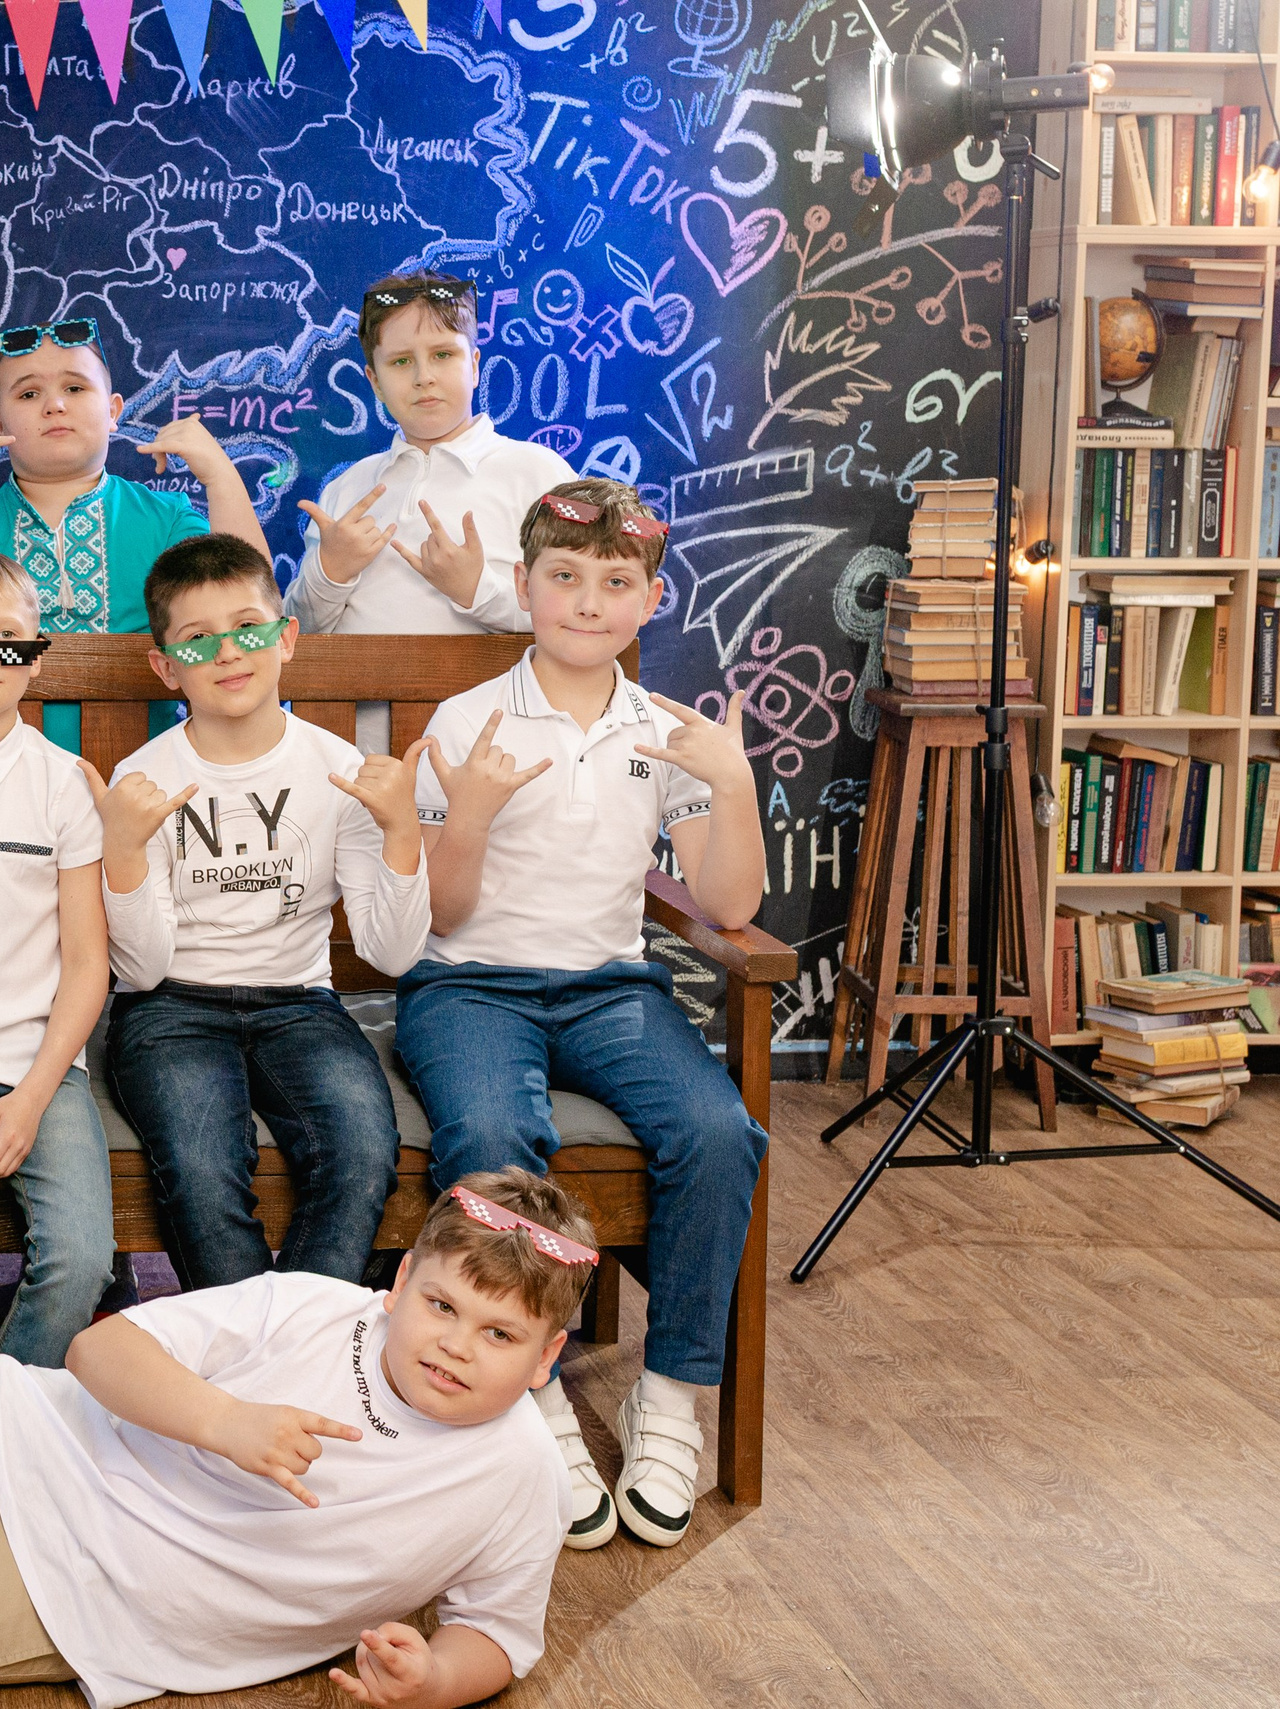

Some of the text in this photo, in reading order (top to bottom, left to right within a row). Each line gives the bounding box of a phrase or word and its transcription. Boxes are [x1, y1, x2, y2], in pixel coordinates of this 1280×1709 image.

[158, 164, 263, 218] Дніпро
[291, 183, 408, 226] Донецьк
[161, 273, 300, 318] Запоріжжя
[321, 352, 628, 436] SOOL
[628, 759, 651, 779] DG
[192, 857, 293, 883] BROOKLYN
[222, 880, 261, 892] URBAN
[282, 883, 304, 917] CIT
[1156, 932, 1168, 973] ОЗИЦИЯ
[353, 1354, 365, 1375] not
[357, 1376, 370, 1398] my
[362, 1399, 399, 1439] problem
